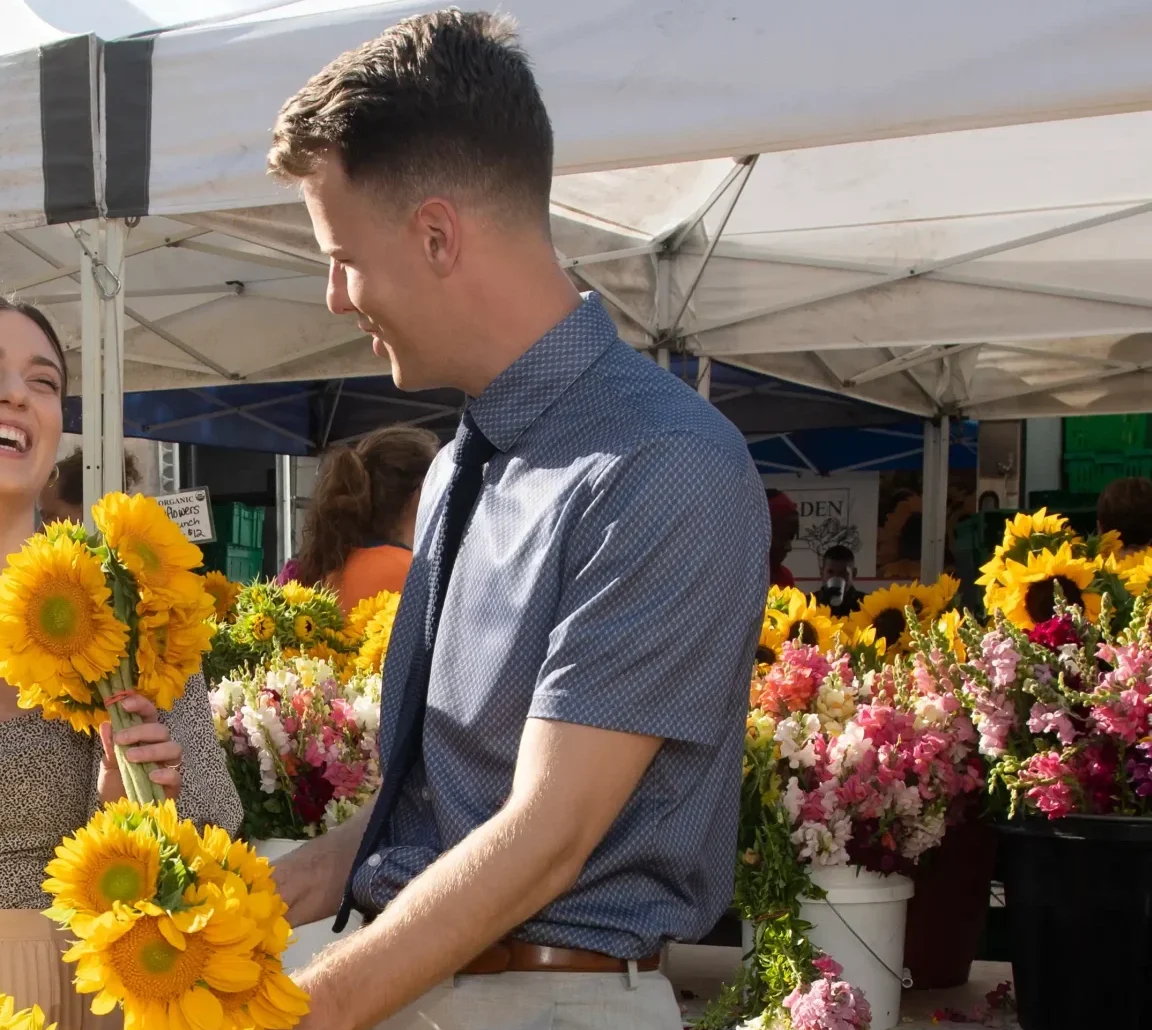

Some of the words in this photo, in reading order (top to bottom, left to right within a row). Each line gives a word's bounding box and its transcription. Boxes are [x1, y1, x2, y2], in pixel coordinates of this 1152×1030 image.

[158, 496, 194, 506] ORGANIC
[165, 505, 200, 519] flowers
[177, 518, 200, 528] unch
[187, 529, 206, 538] $12
